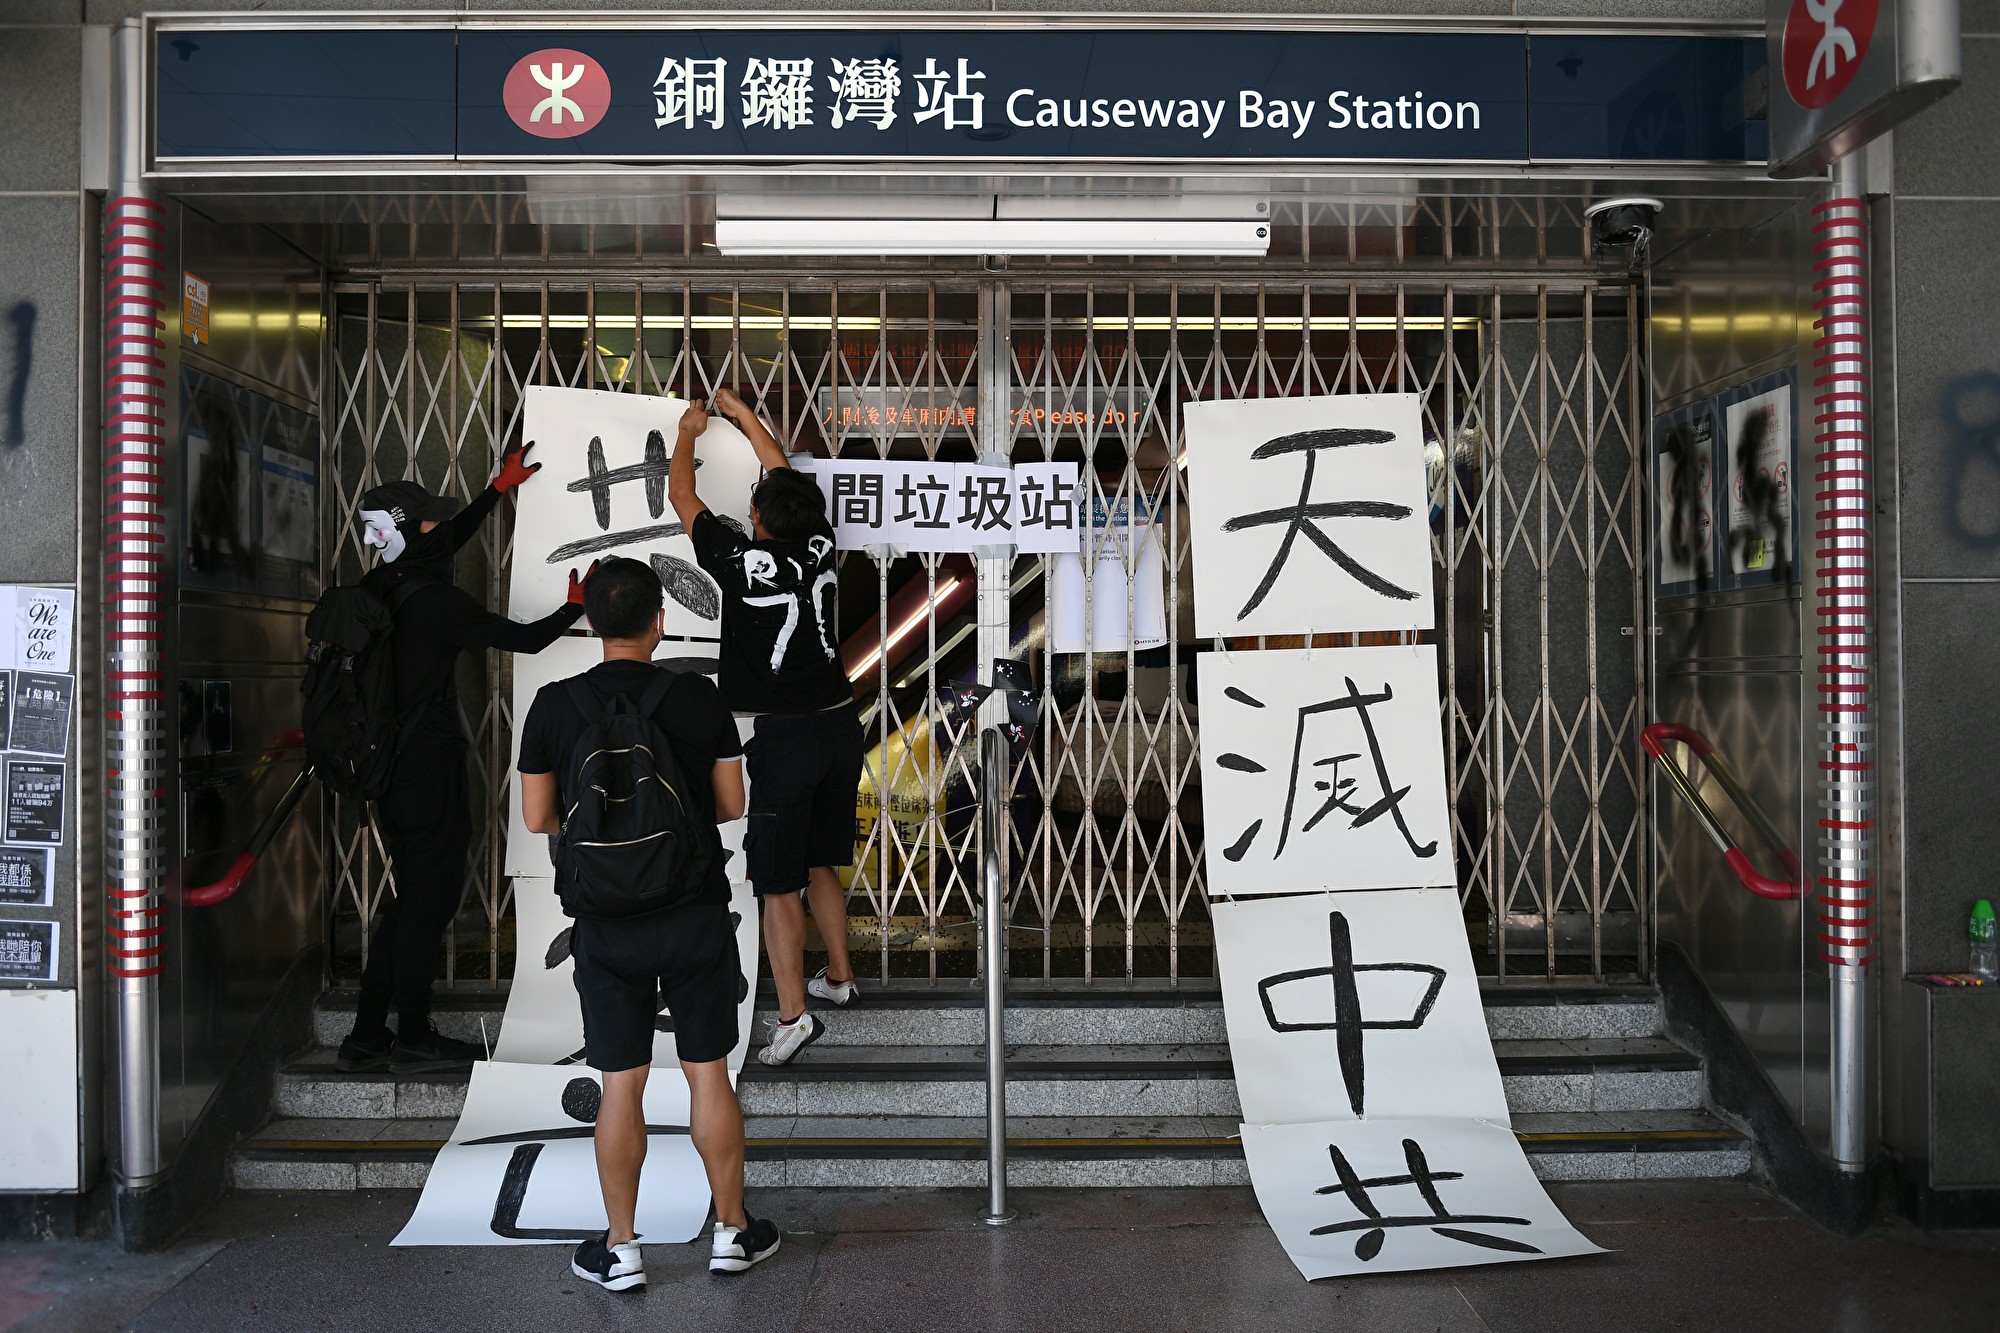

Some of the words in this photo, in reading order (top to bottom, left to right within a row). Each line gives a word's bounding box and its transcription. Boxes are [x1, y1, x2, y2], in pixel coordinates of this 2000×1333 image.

[653, 57, 986, 130] 銅鑼灣站
[1006, 88, 1225, 139] Causeway
[1239, 90, 1316, 139] Bay
[1328, 90, 1480, 130] Station
[800, 472, 1074, 532] 間垃圾站
[29, 602, 58, 626] We
[28, 627, 57, 641] are
[26, 641, 56, 661] One
